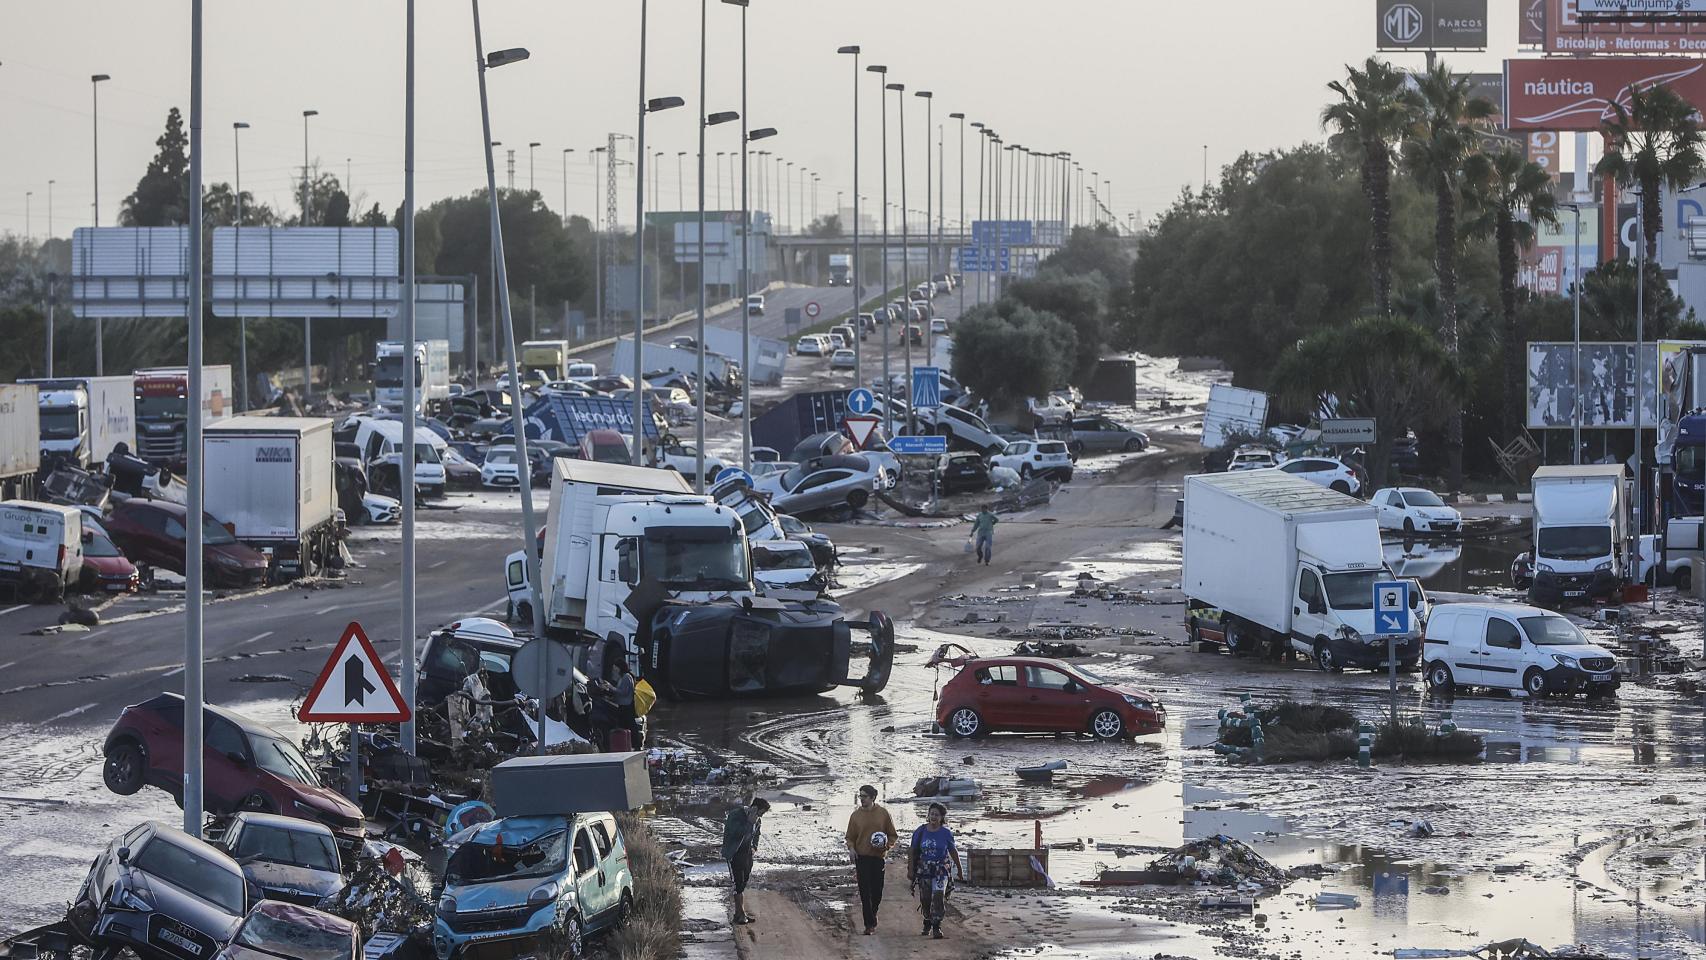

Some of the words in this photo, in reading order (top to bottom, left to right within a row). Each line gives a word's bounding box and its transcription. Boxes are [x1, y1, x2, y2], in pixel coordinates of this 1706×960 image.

[1595, 0, 1691, 10] wwwfunjumpes
[1386, 7, 1419, 39] MG
[1556, 37, 1606, 50] Bricolaje
[1615, 37, 1670, 49] Reformas
[1524, 78, 1594, 95] náutica
[571, 405, 634, 424] leonardo
[257, 447, 292, 457] NIKA
[4, 511, 32, 523] Grupo
